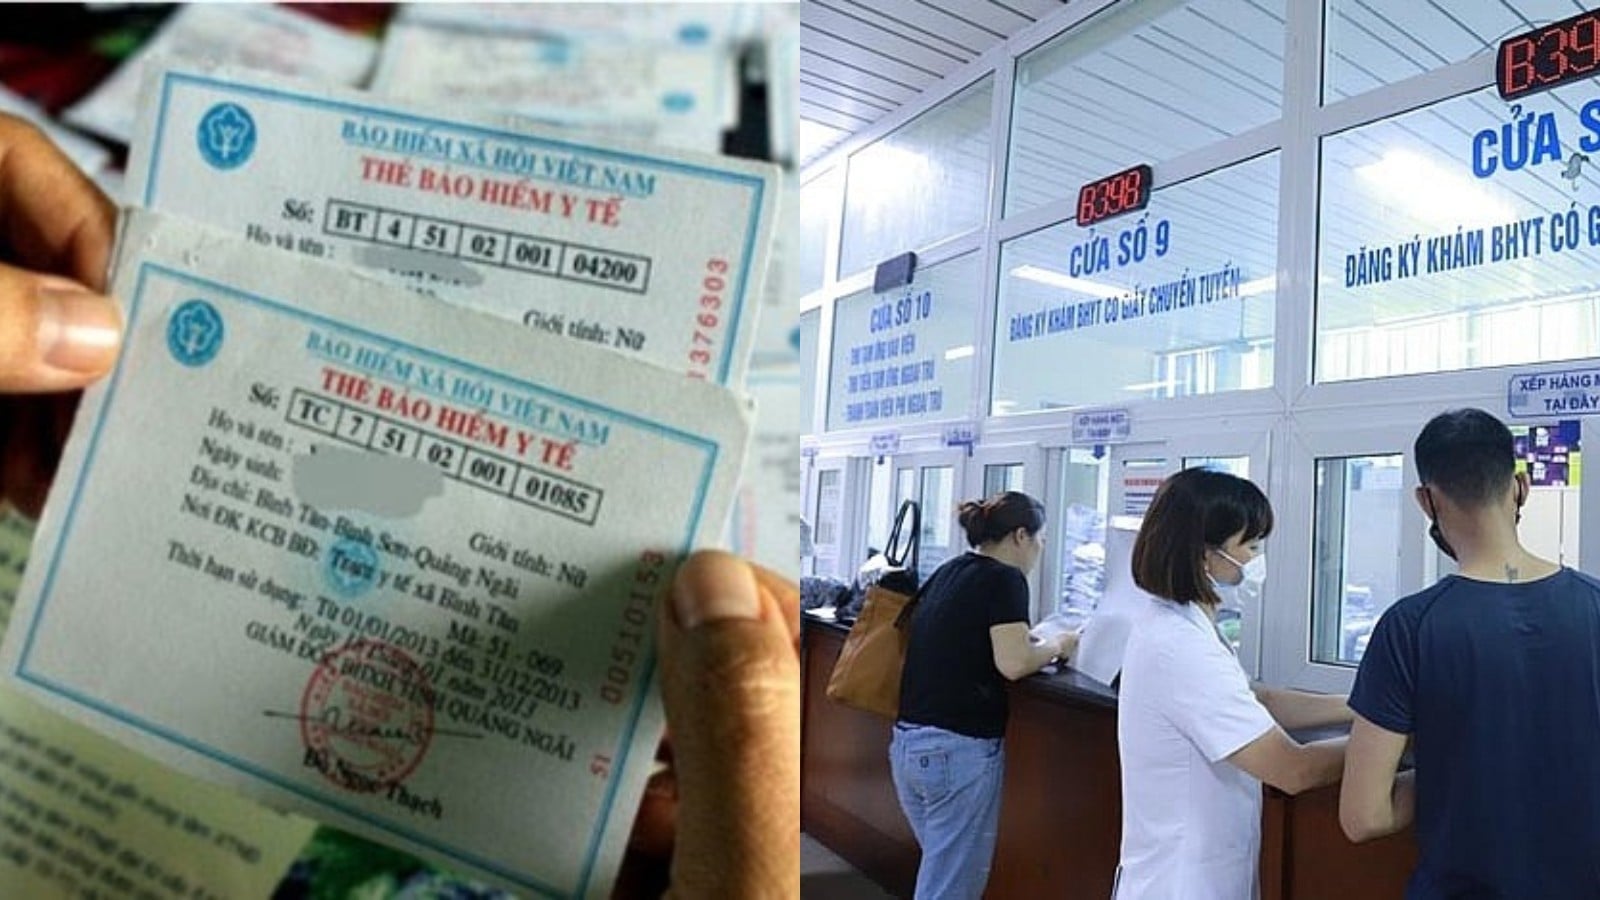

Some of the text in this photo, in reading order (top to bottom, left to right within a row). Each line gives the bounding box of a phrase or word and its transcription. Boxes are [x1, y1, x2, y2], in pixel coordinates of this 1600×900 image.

[341, 119, 657, 196] BẢO HIỂM XÃ HỘI VIỆT NAM
[1472, 104, 1562, 179] CỬA
[281, 198, 315, 223] Số:
[361, 155, 626, 227] THẺ BẢO HIỂM Y TẾ
[335, 208, 637, 283] BT 4 51 02 001 04200
[1069, 212, 1170, 279] CỬA SỐ 9
[1345, 246, 1392, 288] ĐĂNG
[1398, 234, 1421, 279] KÝ
[1426, 225, 1484, 274] KHÁM
[1491, 216, 1544, 263] BHYT
[1550, 201, 1580, 252] CÓ
[916, 291, 932, 321] 10
[1149, 268, 1196, 314] CHUYỂN
[1199, 261, 1241, 304] TUYẾN
[523, 309, 645, 351] Giới tính: Nữ
[1520, 376, 1546, 391] XẾP
[1549, 372, 1591, 390] HÀNG
[320, 367, 579, 471] THẺ BẢO HIỂM Y TẾ
[556, 411, 612, 445] NAM
[300, 399, 589, 514] TC 7 51 02 001 01085
[245, 515, 287, 547] KCB
[469, 532, 511, 563] Giới
[512, 546, 554, 577] tính:
[245, 618, 295, 654] GIÁM
[341, 605, 440, 660] 01/01/2013
